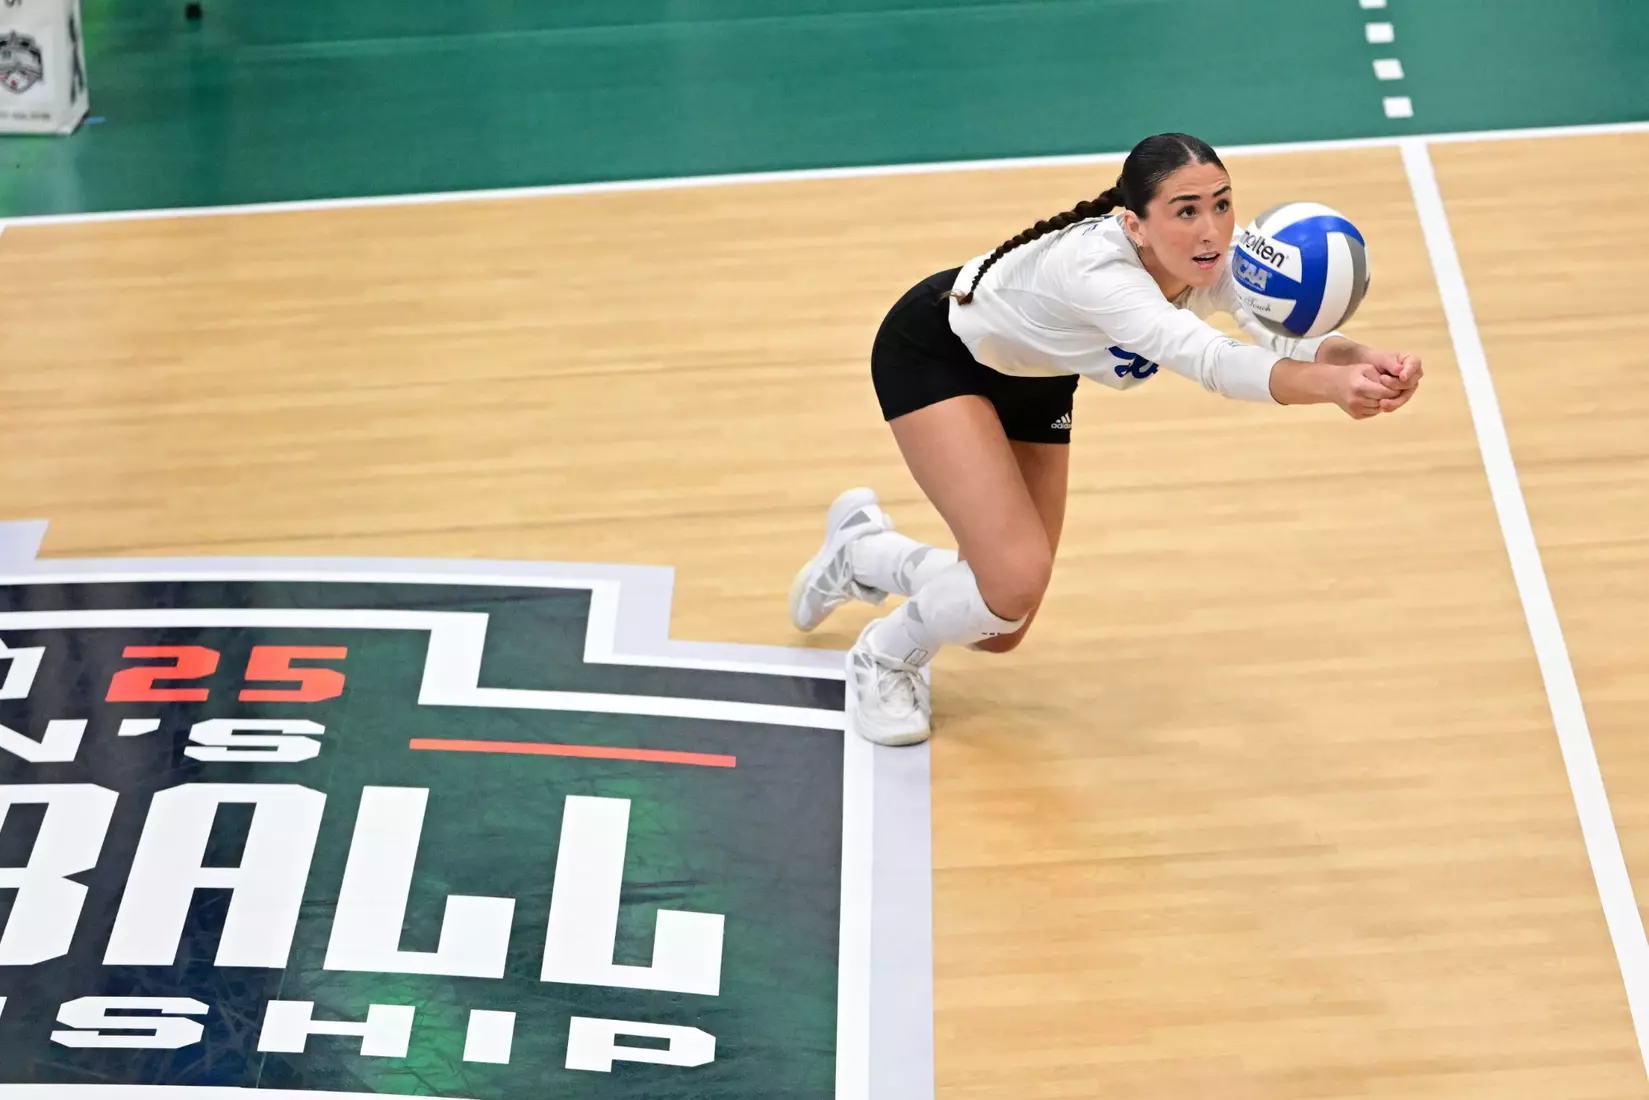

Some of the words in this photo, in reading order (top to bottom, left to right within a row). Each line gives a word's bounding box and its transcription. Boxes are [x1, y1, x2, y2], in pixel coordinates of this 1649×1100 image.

[106, 646, 346, 702] 25
[0, 784, 726, 997] BALL
[0, 996, 717, 1073] SHIP
